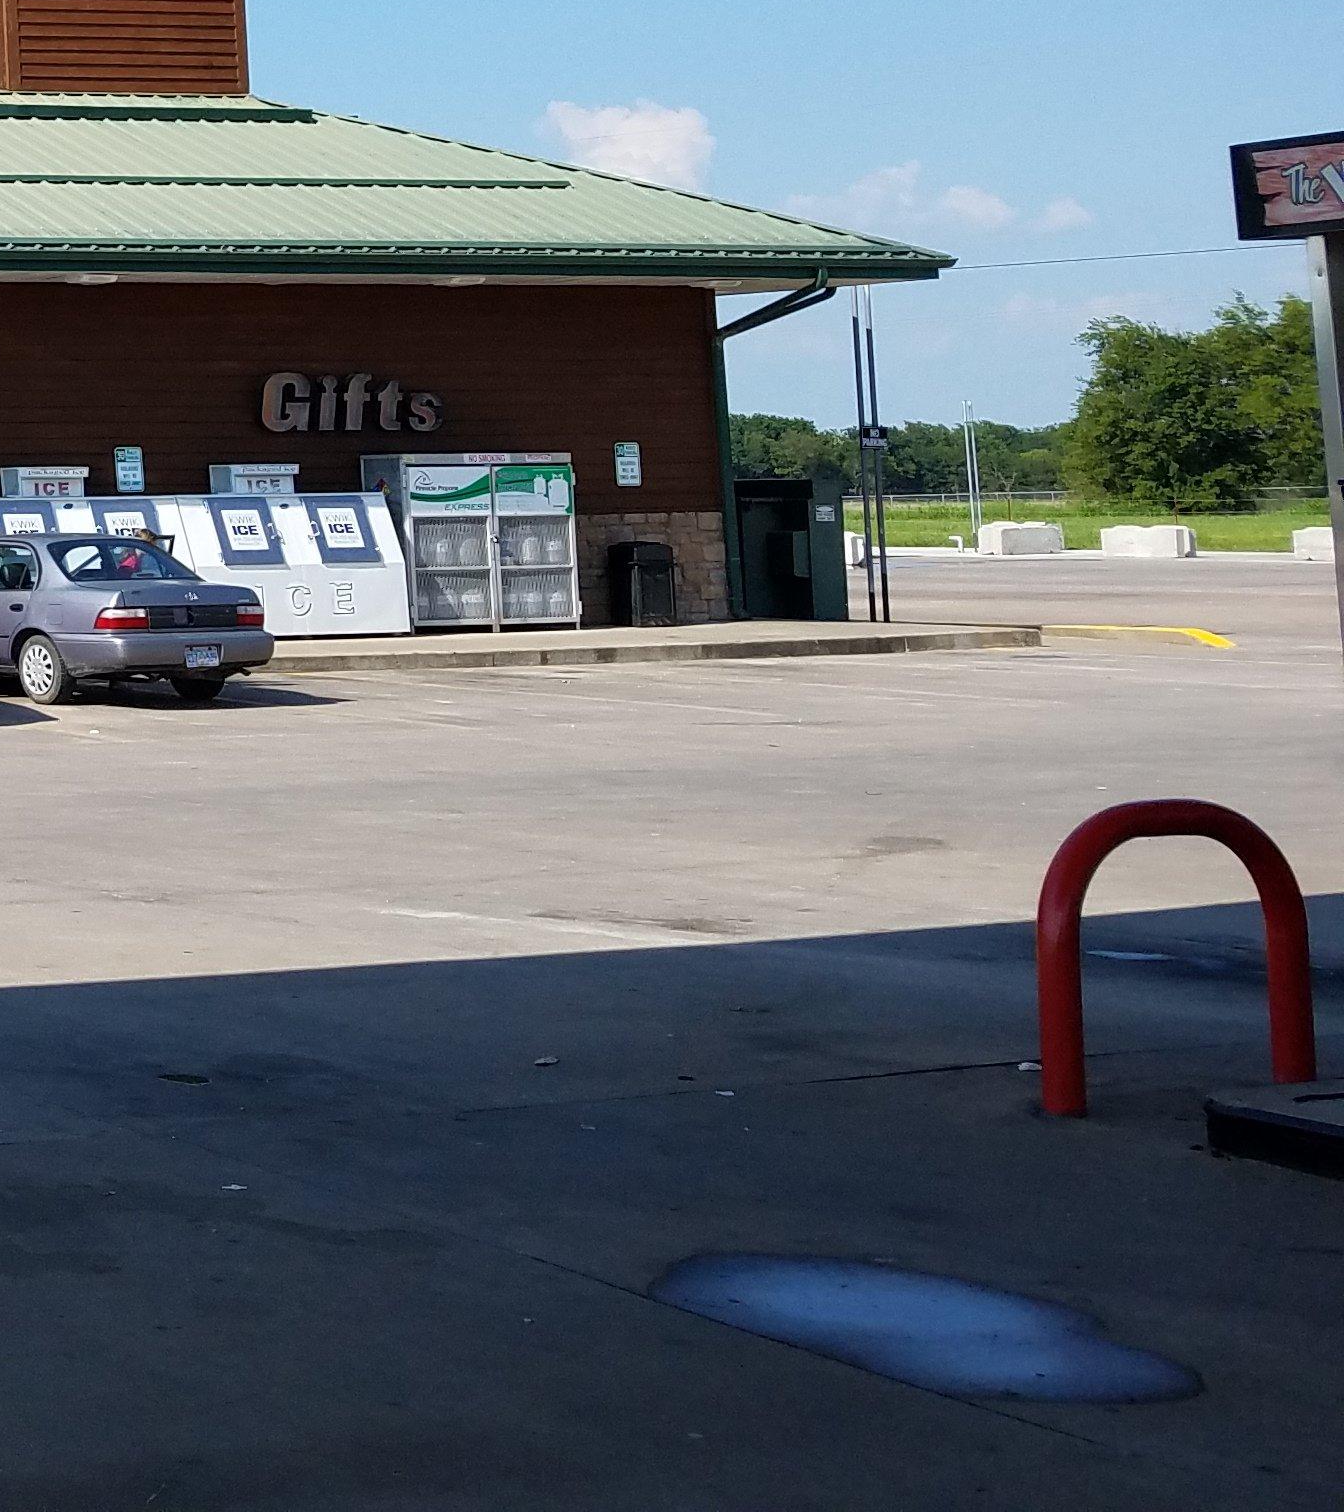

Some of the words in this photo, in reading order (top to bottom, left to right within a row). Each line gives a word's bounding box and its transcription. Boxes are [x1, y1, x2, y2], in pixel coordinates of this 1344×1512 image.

[1281, 161, 1325, 206] The
[261, 372, 444, 432] Gifts
[468, 455, 477, 463] NO
[478, 454, 506, 463] SMOKING
[34, 482, 69, 496] ICE
[247, 478, 280, 493] ICE
[444, 503, 490, 511] EXPRESS
[112, 518, 140, 527] KWIK
[229, 515, 255, 524] KWIK
[325, 513, 353, 522] KWIK
[11, 520, 39, 528] KWIK
[328, 523, 355, 534] ICE
[232, 525, 259, 536] ICE
